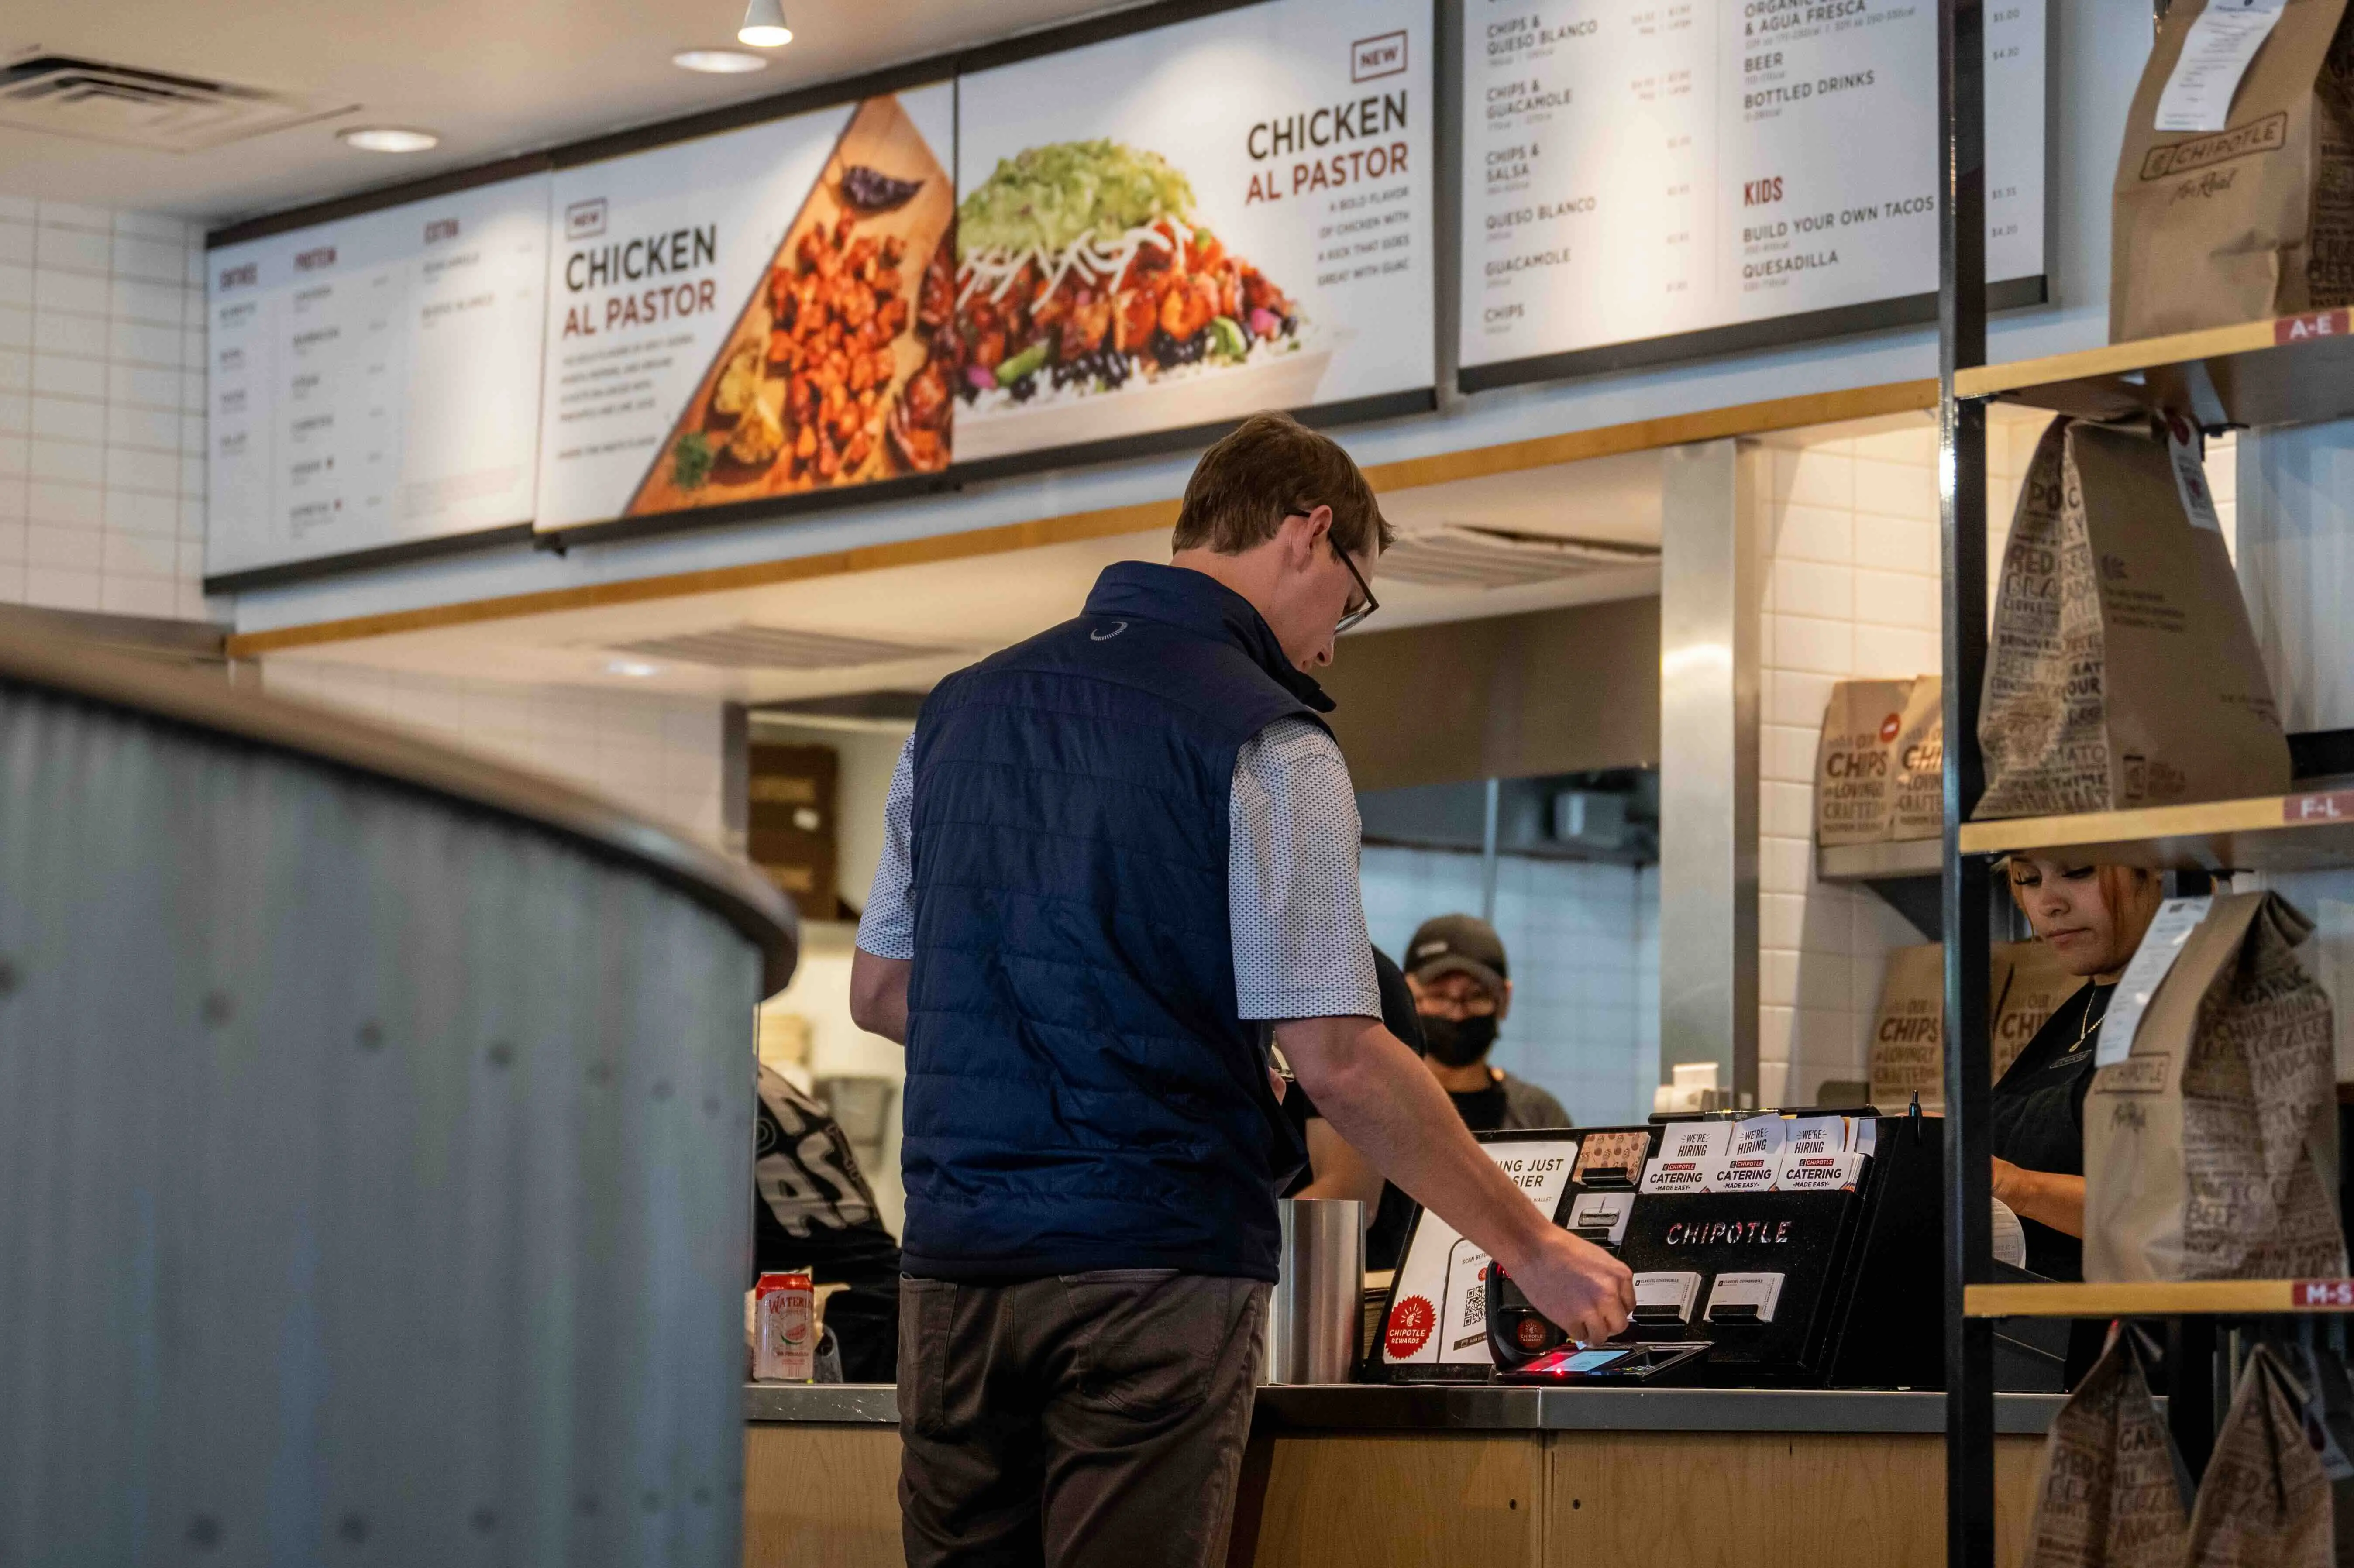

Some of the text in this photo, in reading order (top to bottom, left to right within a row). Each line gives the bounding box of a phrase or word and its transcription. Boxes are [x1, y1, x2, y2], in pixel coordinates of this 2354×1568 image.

[1759, 13, 1801, 33] AGUA
[1807, 0, 1865, 23] FRESCA
[1487, 19, 1525, 39] CHIPS
[1487, 19, 1598, 56] QUESO BLANCO
[1360, 46, 1397, 68] NEW
[1745, 52, 1784, 72] BEER
[1487, 84, 1525, 103] CHIPS
[1744, 69, 1875, 109] BOTTLED DRINKS
[1487, 89, 1572, 120] GUACAMOLE
[1247, 89, 1407, 161] CHICKEN
[2176, 120, 2278, 165] CHIPOTLE
[1487, 148, 1525, 166] CHIPS
[1245, 141, 1408, 206] AL PASTOR
[1487, 164, 1529, 183] SALSA
[1744, 176, 1784, 207] KIDS
[1487, 197, 1597, 230] QUESO BLANCO
[1743, 196, 1935, 243] BUILD YOUR OWN TACOS
[566, 223, 716, 293] CHICKEN
[1486, 248, 1572, 277] GUACAMOLE
[1742, 250, 1839, 279] QUESADILLA
[563, 279, 716, 339] AL PASTOR
[1485, 304, 1525, 323] CHIPS
[2290, 314, 2333, 340] A-E
[1827, 751, 1889, 778] CHIPS
[2301, 798, 2341, 820] F-L
[1879, 1017, 1939, 1043] CHIPS
[1687, 1133, 1706, 1143] WE'RE
[1745, 1128, 1764, 1140] WE'RE
[1800, 1129, 1821, 1140] WE'RE
[1678, 1145, 1707, 1157] HIRING
[1737, 1139, 1767, 1155] HIRING
[1795, 1141, 1824, 1153] HIRING
[1527, 1159, 1564, 1172] JUST
[1717, 1169, 1772, 1181] CATERING
[1786, 1169, 1842, 1179] CATERING
[1650, 1173, 1703, 1183] CATERING
[1667, 1221, 1792, 1245] CHIPOTLE
[2306, 1284, 2353, 1303] M-S
